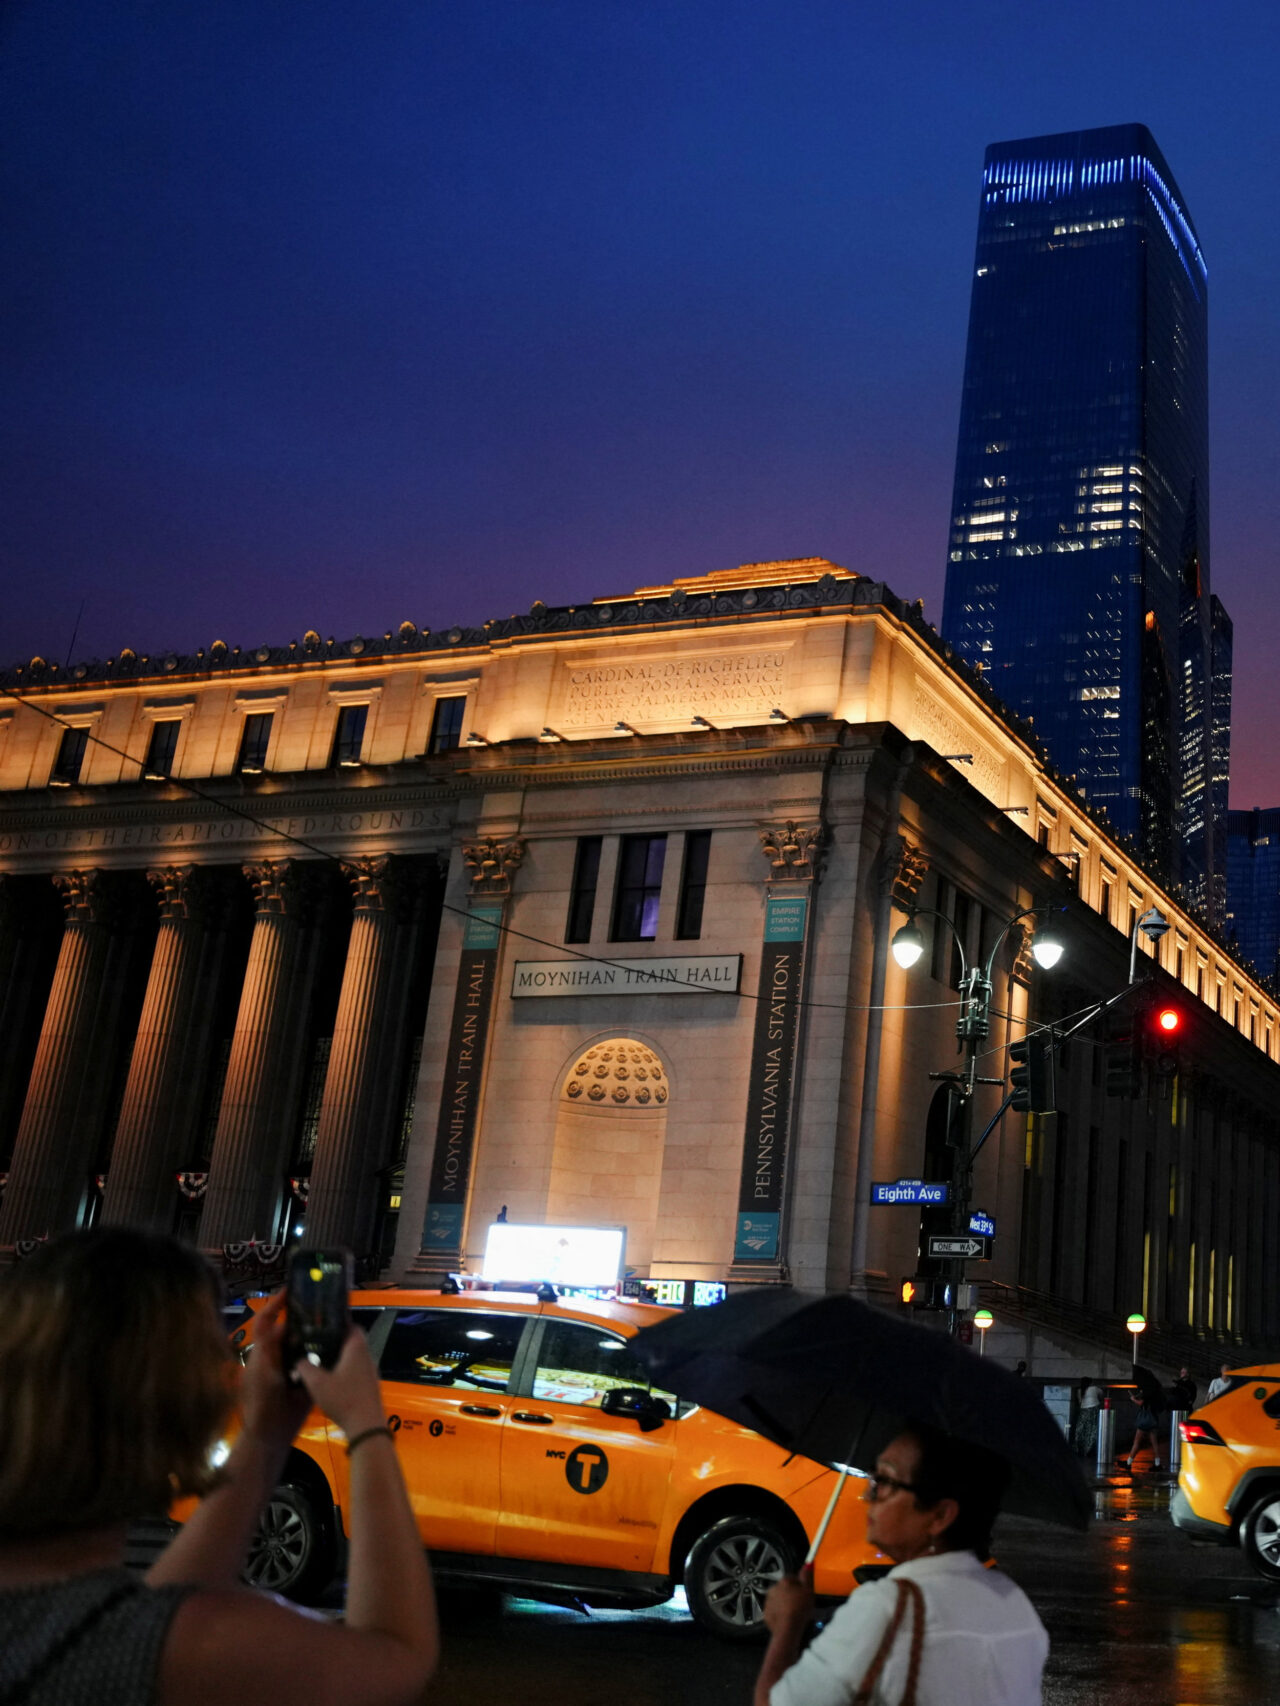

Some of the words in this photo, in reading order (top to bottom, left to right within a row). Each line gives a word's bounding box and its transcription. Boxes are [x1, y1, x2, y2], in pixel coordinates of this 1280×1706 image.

[570, 681, 632, 699] PUBLIC
[641, 677, 703, 693] POSTAL
[712, 669, 783, 687] SERVICE
[572, 667, 656, 685] CARDINAL
[663, 662, 685, 677] DE
[691, 655, 785, 675] RICHELIEU
[568, 696, 623, 712] PIERRE
[45, 831, 73, 849] OF
[87, 826, 162, 847] THEIR
[174, 817, 317, 842] APPOINTED
[330, 808, 442, 832] ROUNDS
[466, 959, 486, 1008] HALL
[519, 970, 616, 987] MOYNIHAN
[624, 967, 679, 984] TRAIN
[686, 966, 732, 982] HALL
[457, 1014, 478, 1075] TRAIN
[754, 1046, 782, 1200] PENNSYLVANIA
[768, 953, 790, 1040] STATION
[442, 1080, 470, 1193] MOYNIHAN
[878, 1187, 915, 1203] Eighth
[918, 1188, 942, 1200] Ave
[970, 1217, 980, 1231] West
[937, 1243, 952, 1251] ONE
[959, 1243, 976, 1251] WAY
[546, 1450, 566, 1459] NYC
